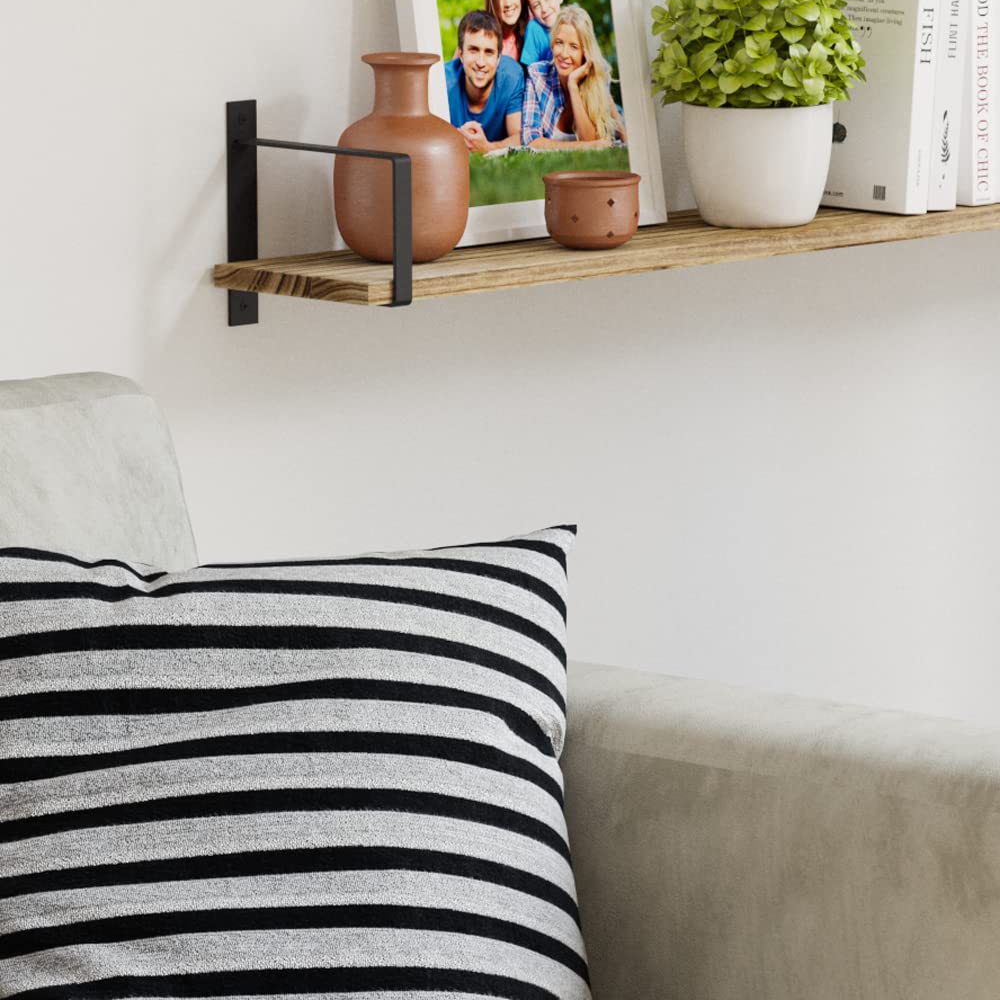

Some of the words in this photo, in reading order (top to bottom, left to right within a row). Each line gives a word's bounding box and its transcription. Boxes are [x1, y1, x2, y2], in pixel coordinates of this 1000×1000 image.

[920, 7, 935, 65] FISH
[947, 23, 959, 58] FLINT
[977, 22, 989, 59] THE
[977, 65, 989, 115] BOOK
[977, 119, 989, 143] OF
[977, 148, 989, 192] CHIC
